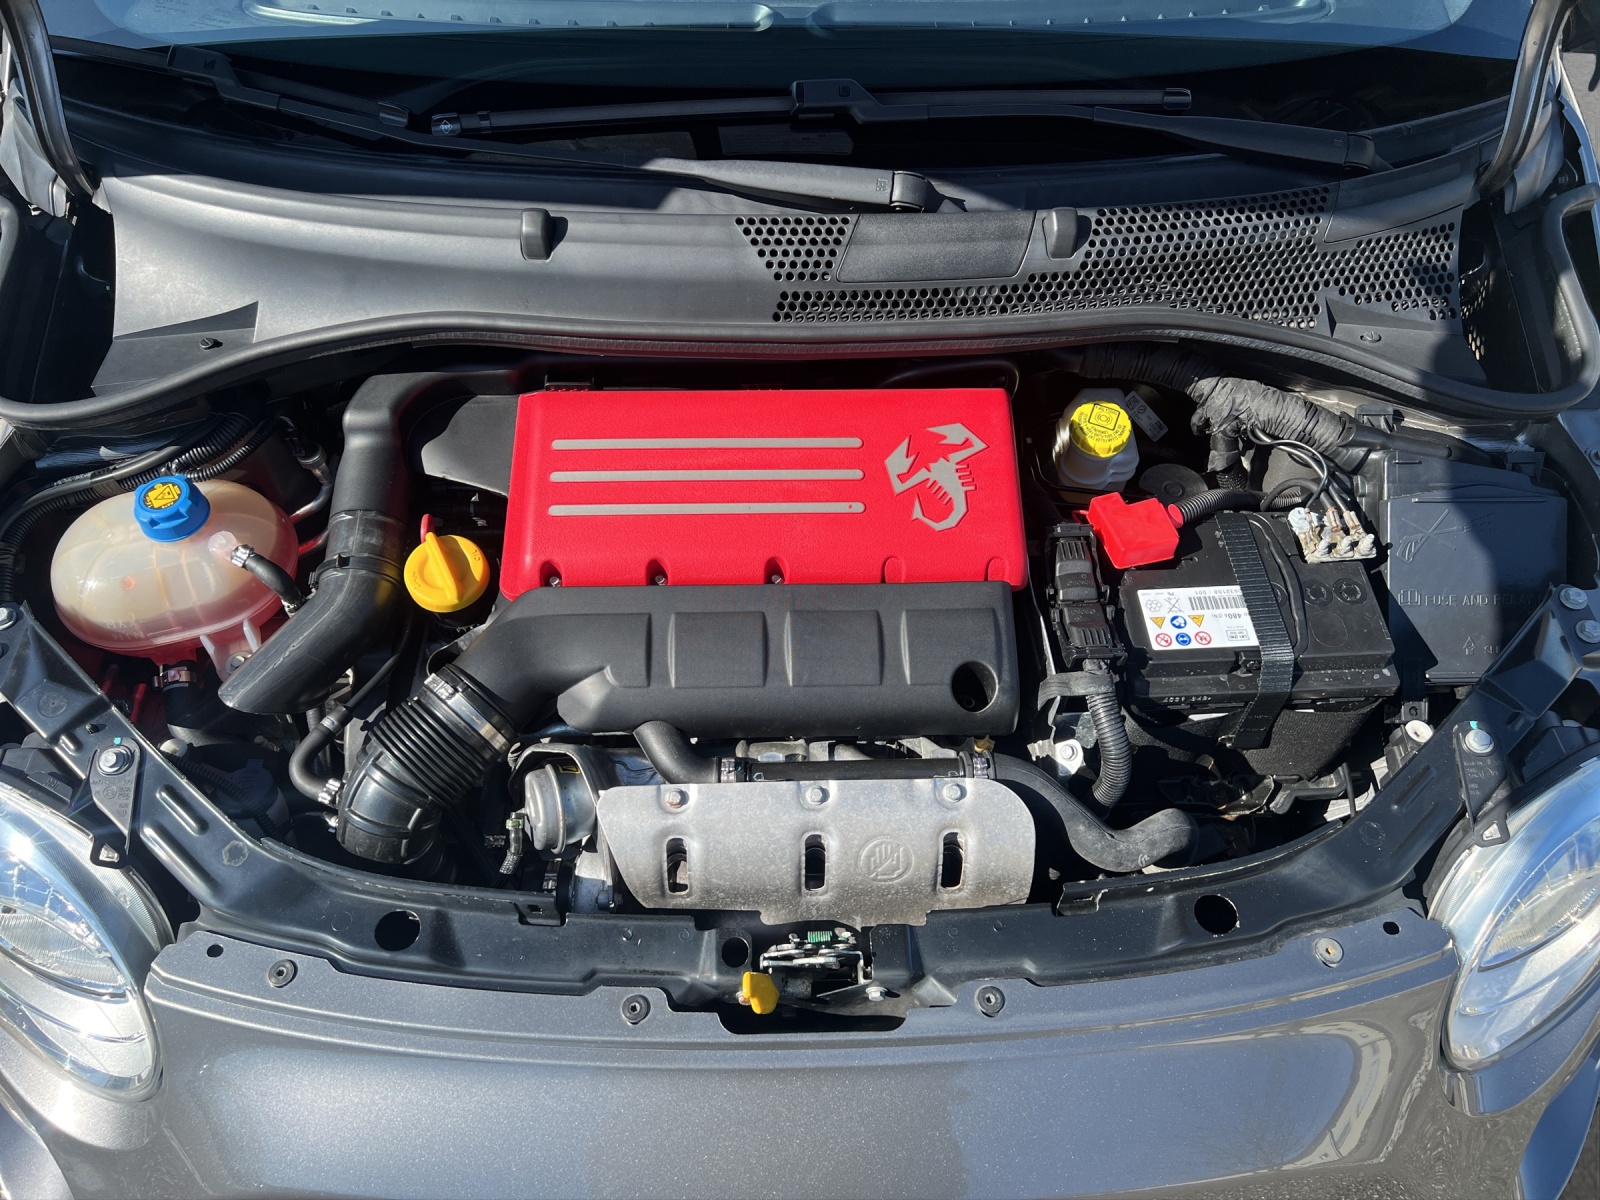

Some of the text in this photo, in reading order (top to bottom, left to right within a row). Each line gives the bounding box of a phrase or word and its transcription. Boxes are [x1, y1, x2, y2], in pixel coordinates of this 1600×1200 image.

[472, 549, 481, 561] OIL
[1425, 594, 1457, 607] FUSE
[1462, 594, 1489, 606] AND
